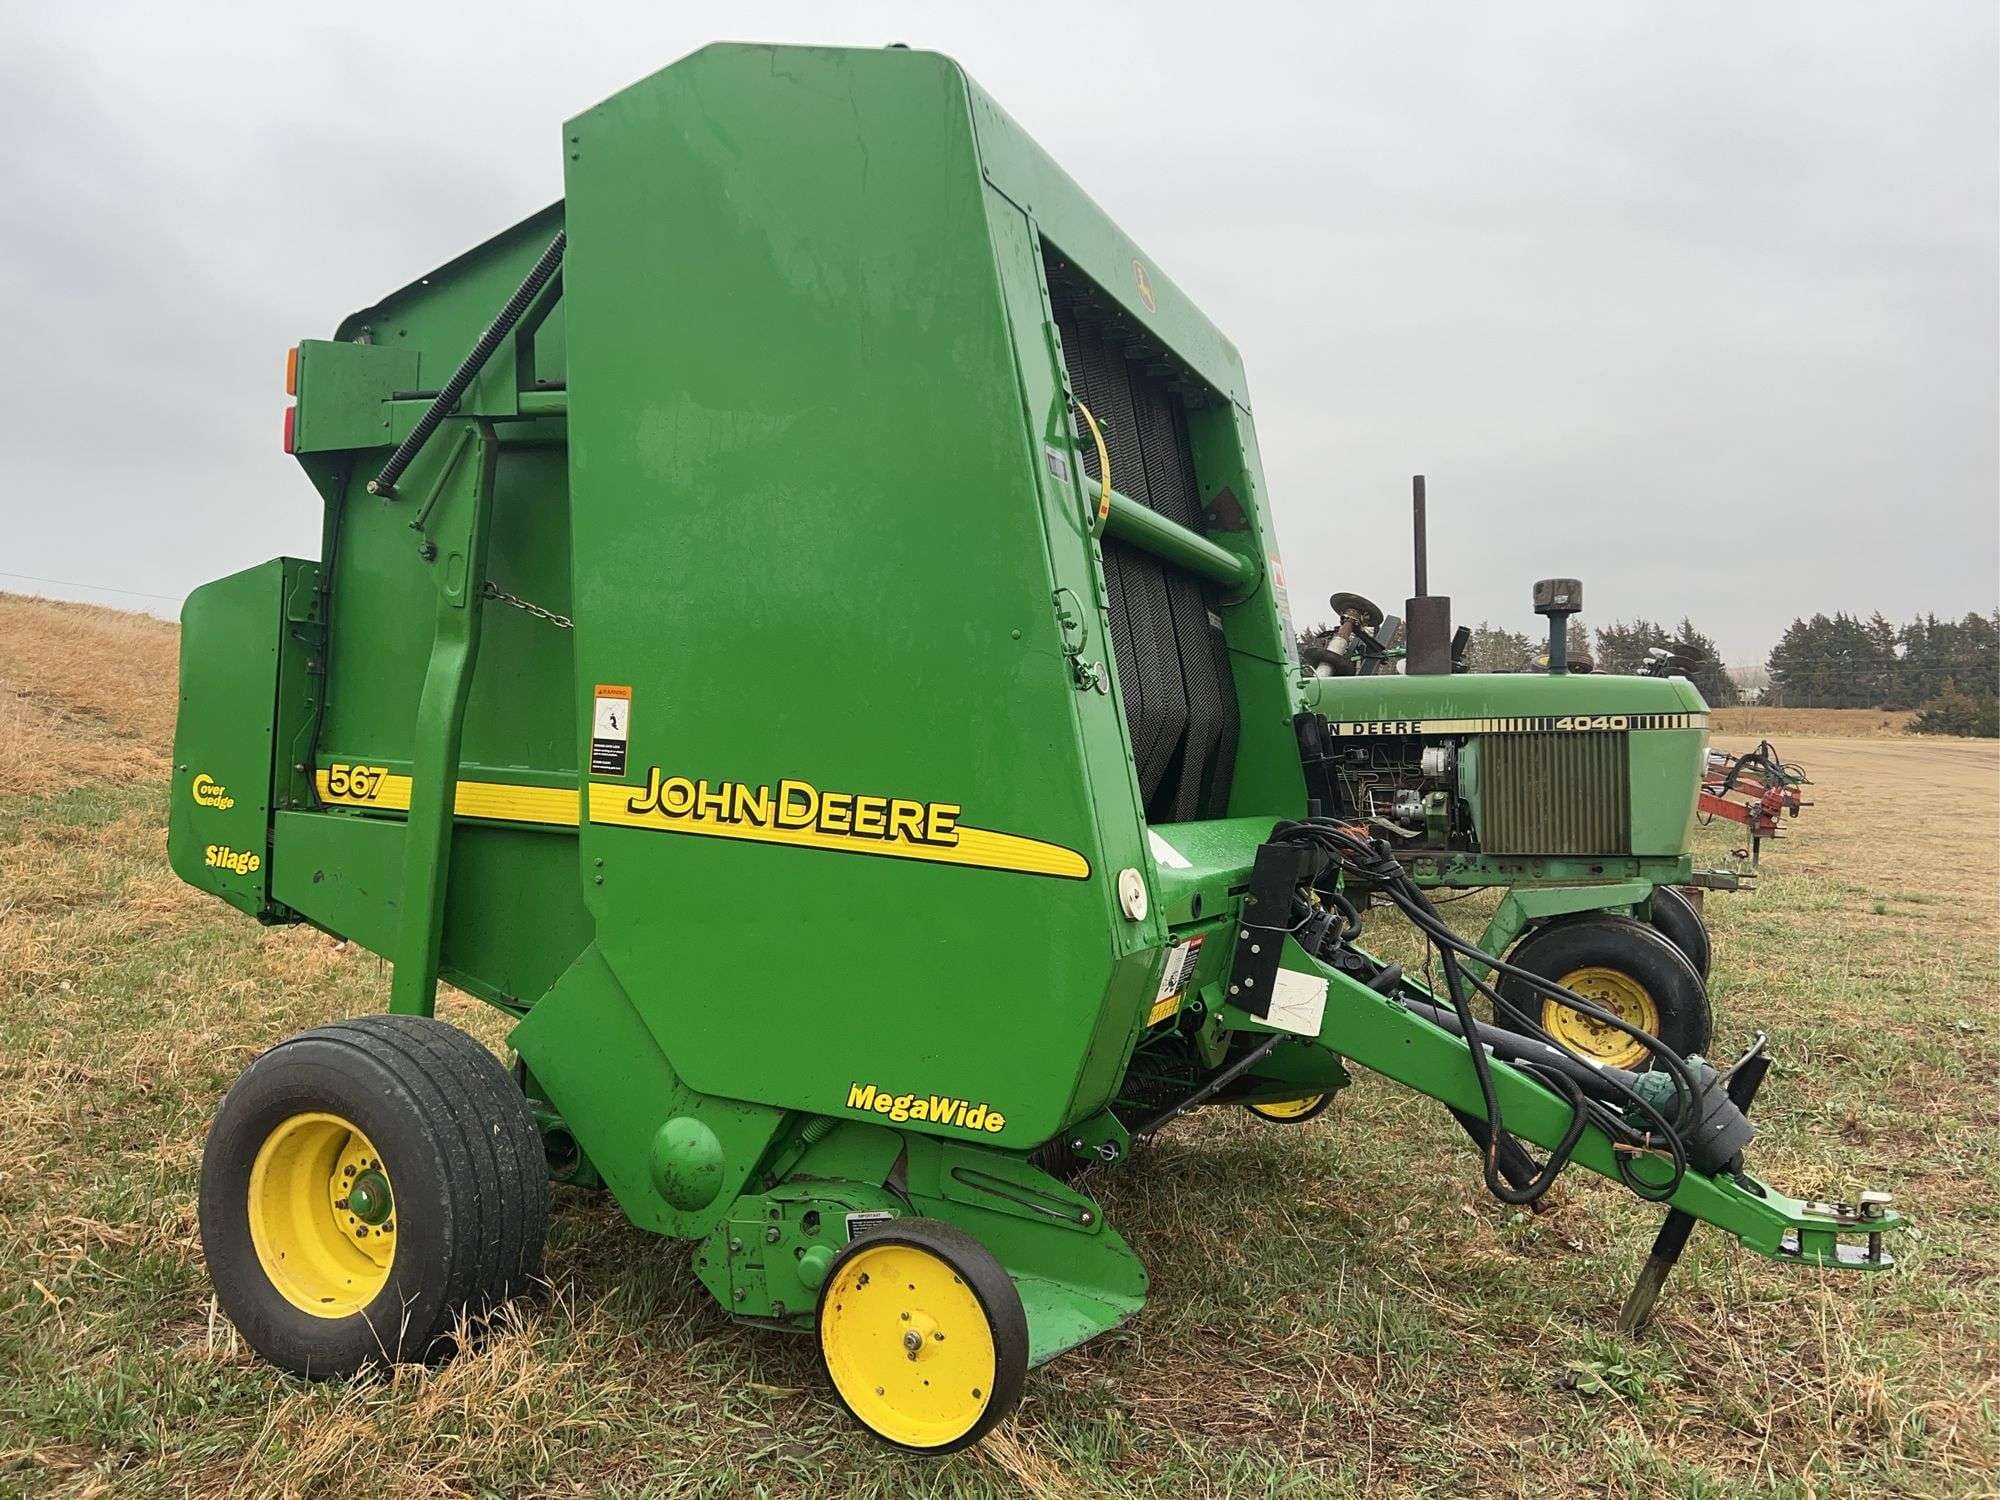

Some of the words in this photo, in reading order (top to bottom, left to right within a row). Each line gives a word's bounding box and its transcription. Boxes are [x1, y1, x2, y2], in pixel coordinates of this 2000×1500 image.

[1353, 721, 1422, 735] DEERE
[1556, 716, 1628, 731] 4040
[328, 763, 389, 800] 567
[627, 767, 769, 827] JOHN
[774, 779, 961, 847] DEERE
[204, 844, 261, 875] Silage
[846, 1081, 1007, 1134] MegaWide
